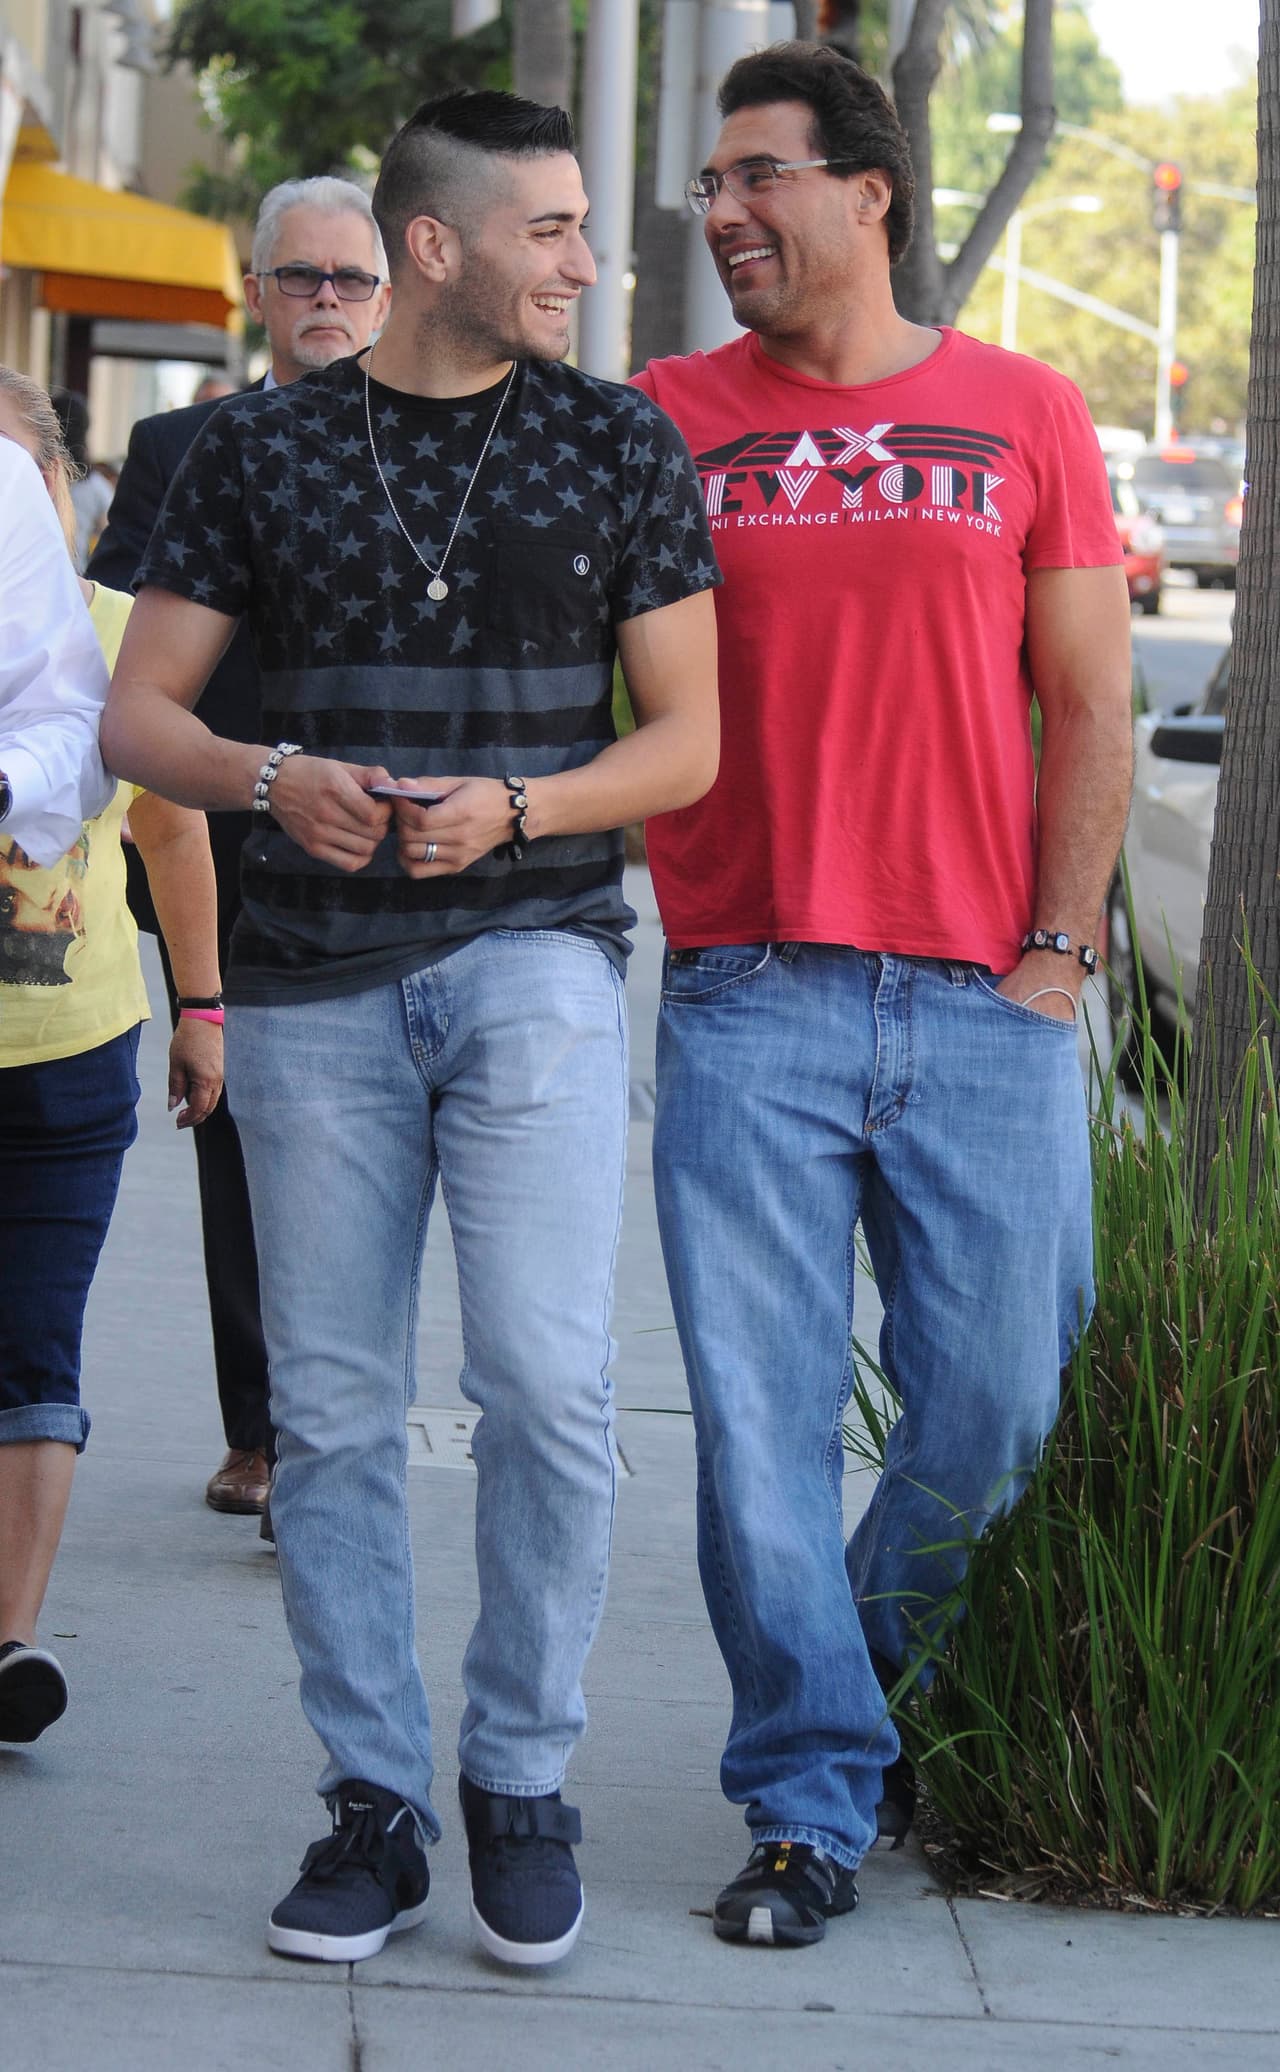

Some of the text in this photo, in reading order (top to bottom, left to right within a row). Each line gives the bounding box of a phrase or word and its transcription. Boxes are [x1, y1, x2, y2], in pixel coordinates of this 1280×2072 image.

[784, 423, 897, 467] AX
[700, 464, 1006, 522] EW YORK
[711, 507, 1002, 537] NI EXCHANGE MILAN NEW YORK
